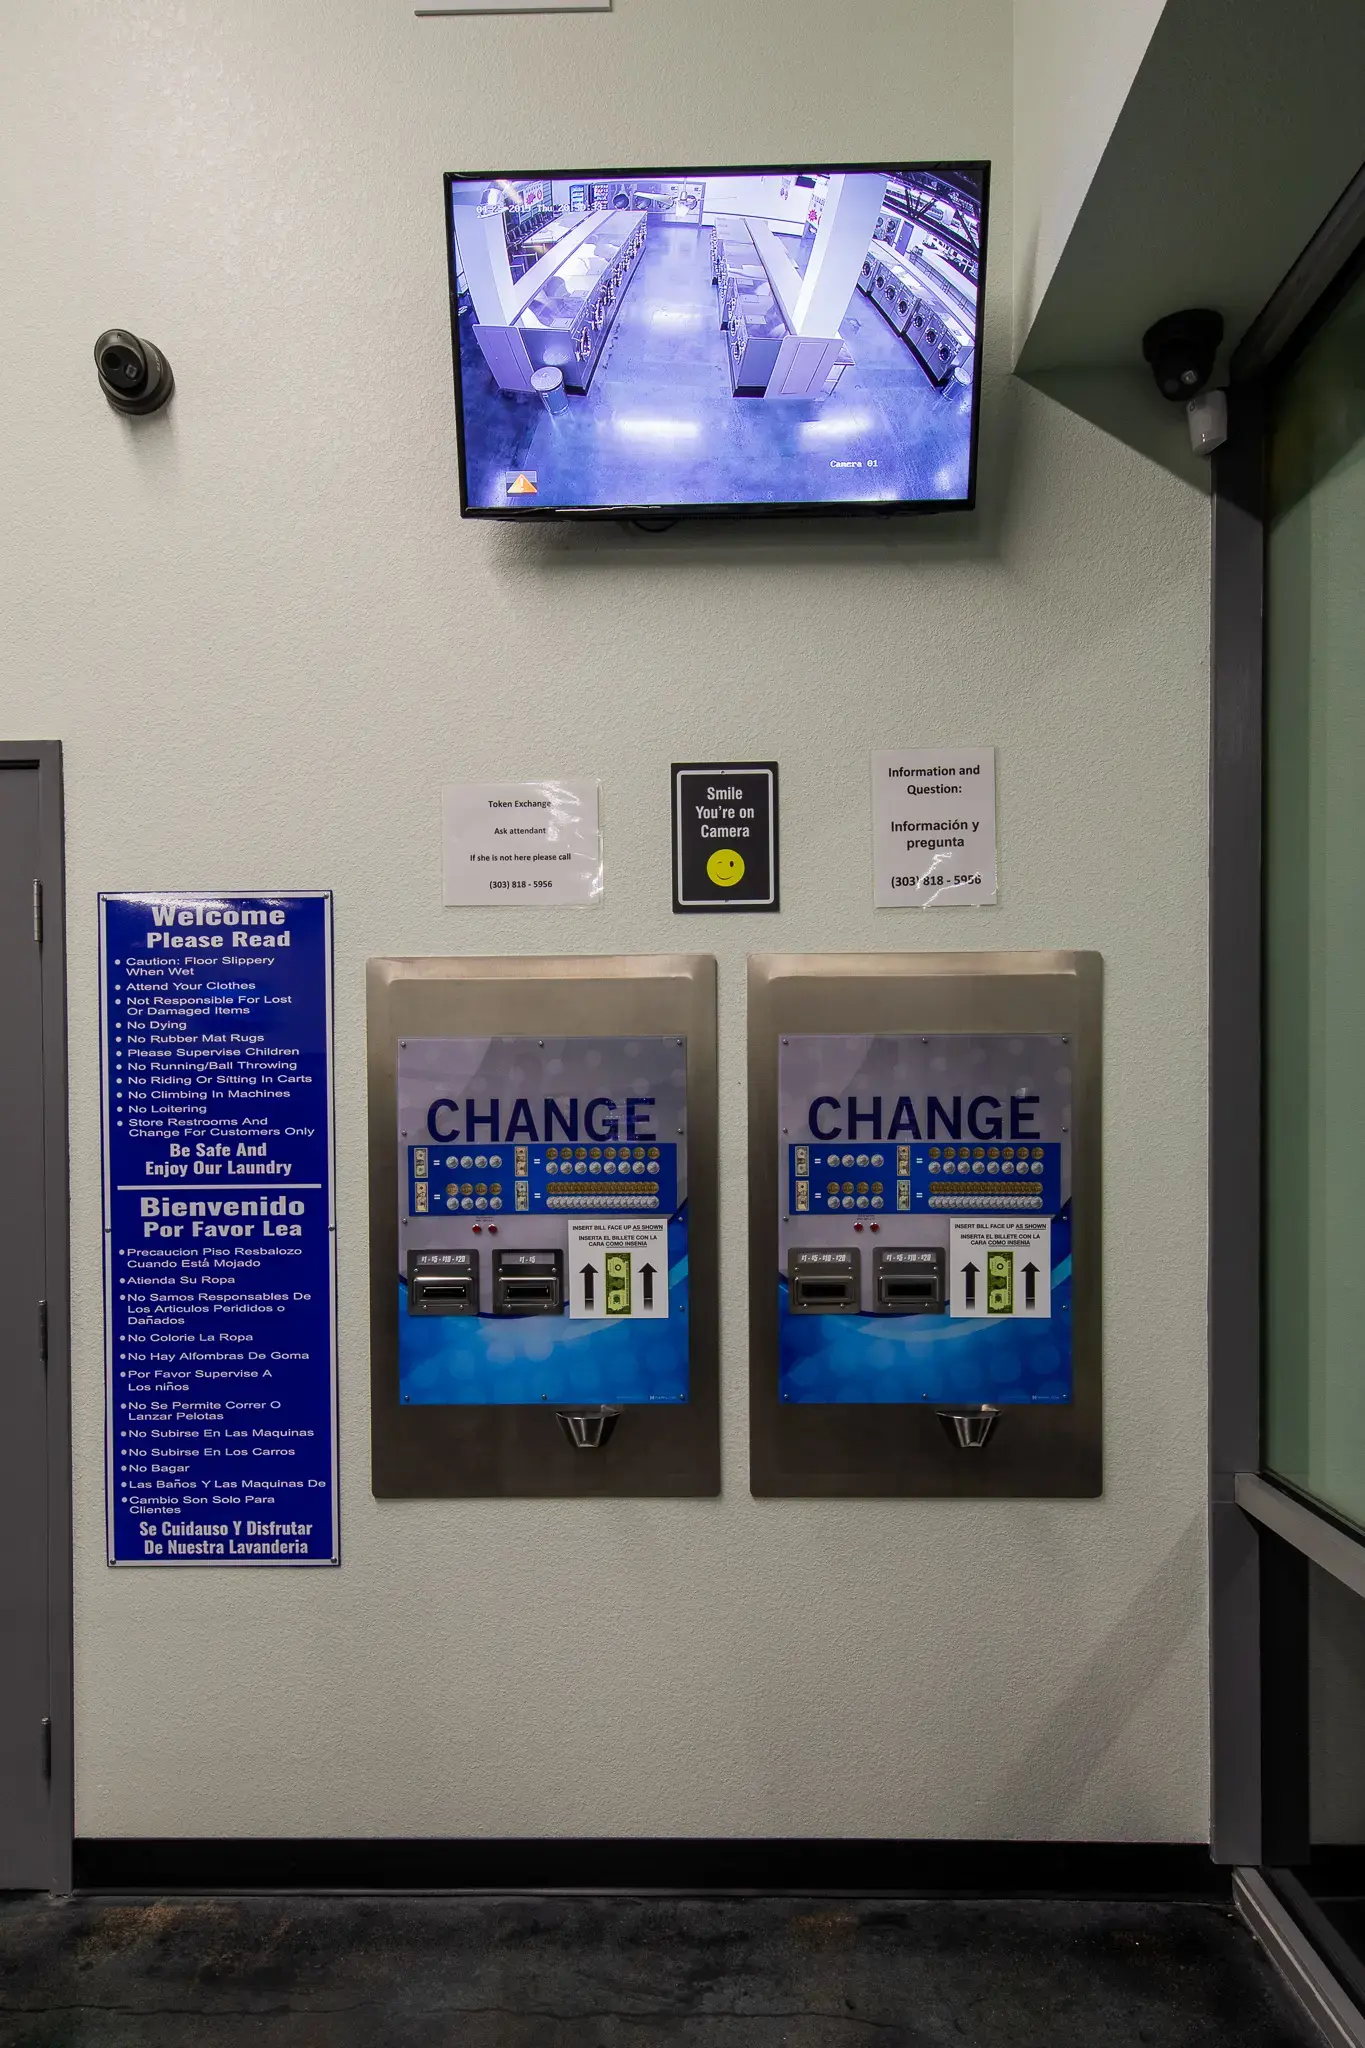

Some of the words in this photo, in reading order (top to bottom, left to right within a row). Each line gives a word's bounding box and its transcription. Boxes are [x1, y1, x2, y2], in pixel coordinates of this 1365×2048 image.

[888, 766, 955, 777] Information
[959, 765, 980, 775] and
[707, 787, 742, 800] Smile
[907, 784, 962, 795] Question:
[515, 800, 551, 809] Exchange
[695, 806, 735, 819] You're
[740, 808, 754, 818] on
[701, 825, 749, 837] Camera
[891, 820, 968, 832] Información
[972, 821, 979, 832] y
[907, 837, 964, 850] pregunta
[533, 854, 556, 862] please
[489, 881, 510, 889] (303)
[923, 876, 943, 885] 818
[152, 907, 285, 926] Welcome
[147, 932, 223, 948] Please
[232, 931, 290, 947] Read
[185, 957, 218, 965] Floor
[222, 956, 274, 966] Slippery
[126, 983, 168, 991] Attend
[173, 982, 202, 990] Your
[206, 981, 256, 989] Clothes
[127, 997, 149, 1005] Not
[154, 996, 233, 1006] Responsible
[264, 995, 292, 1003] Lost
[150, 1035, 198, 1043] Rubber
[202, 1034, 227, 1042] Mat
[231, 1034, 265, 1044] Rugs
[128, 1049, 172, 1057] Please
[176, 1048, 241, 1058] Supervise
[245, 1048, 300, 1056] Children
[150, 1061, 233, 1071] Running/Ball
[237, 1061, 297, 1070] Throwing
[151, 1105, 207, 1115] Loitering
[168, 1118, 238, 1126] Restrooms
[427, 1097, 656, 1143] CHANGE
[808, 1095, 1040, 1141] CHANGE
[129, 1129, 180, 1138] Change
[184, 1128, 206, 1136] For
[210, 1128, 280, 1136] Customers
[285, 1127, 315, 1137] Only
[170, 1144, 190, 1157] Be
[196, 1143, 231, 1157] Safe
[236, 1143, 267, 1156] And
[145, 1162, 188, 1177] Enjoy
[193, 1161, 222, 1175] Our
[228, 1160, 292, 1176] Laundry
[141, 1196, 305, 1217] Bienvenido
[144, 1222, 184, 1238] Por
[192, 1221, 255, 1237] Favor
[263, 1221, 302, 1236] Lea
[127, 1248, 198, 1256] Precaucion
[127, 1260, 177, 1268] Cuando
[181, 1258, 210, 1268] Está
[214, 1260, 261, 1269] Mojado
[180, 1276, 197, 1284] Su
[202, 1276, 235, 1285] Ropa
[150, 1293, 194, 1301] Samos
[199, 1293, 289, 1302] Responsables
[128, 1315, 185, 1325] Dañados
[150, 1334, 195, 1342] Colorie
[200, 1334, 215, 1342] La
[219, 1334, 253, 1343] Ropa
[128, 1371, 150, 1379] Por
[155, 1370, 191, 1378] Favor
[195, 1370, 258, 1379] Supervise
[156, 1382, 189, 1391] niños
[176, 1412, 224, 1420] Pelotas
[129, 1430, 147, 1438] No
[204, 1429, 221, 1437] En
[225, 1429, 248, 1437] Las
[252, 1429, 314, 1438] Maquinas
[151, 1465, 190, 1473] Bagar
[130, 1496, 178, 1504] Cambio
[183, 1496, 208, 1504] Son
[212, 1496, 241, 1504] Solo
[245, 1496, 275, 1504] Para
[130, 1506, 181, 1514] Clientes
[139, 1522, 157, 1536] Se
[162, 1521, 228, 1536] Cuidauso
[233, 1521, 242, 1535] Y
[247, 1521, 312, 1535] Disfrutar
[145, 1541, 163, 1555] De
[168, 1540, 224, 1554] Nuestra
[229, 1540, 308, 1554] Lavanderia
